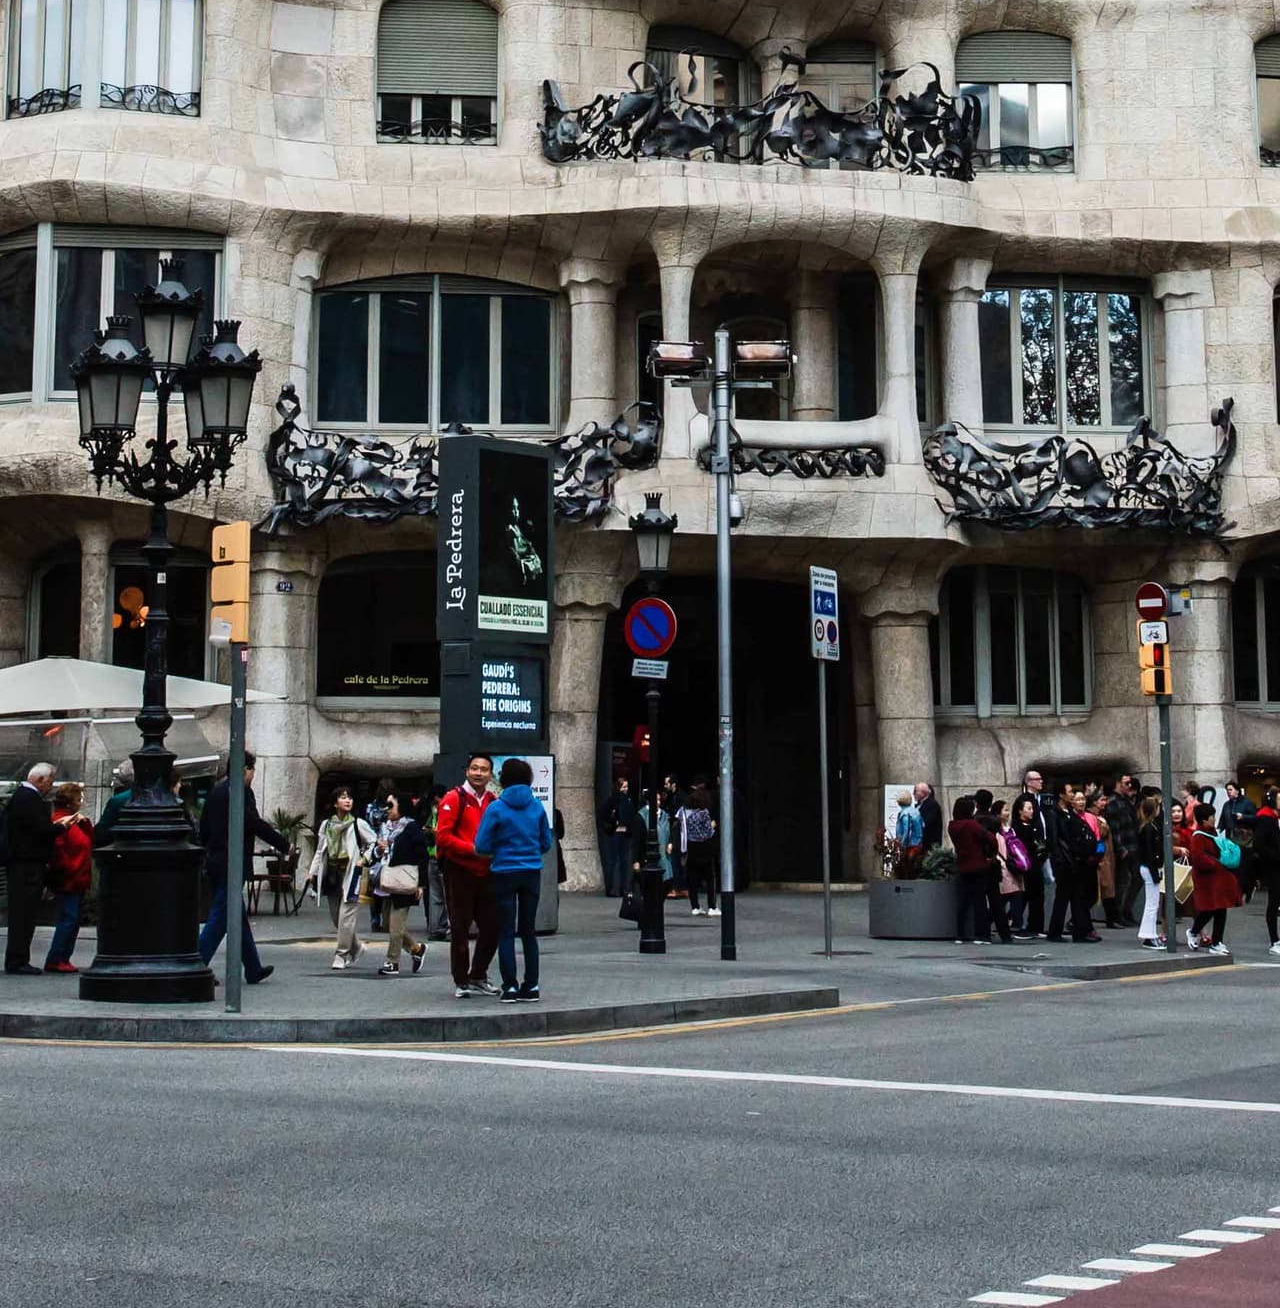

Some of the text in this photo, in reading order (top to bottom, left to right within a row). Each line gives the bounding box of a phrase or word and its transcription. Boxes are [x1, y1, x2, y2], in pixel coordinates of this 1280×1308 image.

[446, 489, 467, 611] La Pedrera
[482, 662, 515, 679] GAUDÍ'S
[392, 675, 428, 684] Pedrera
[482, 680, 521, 696] PEDRERA:
[482, 698, 532, 714] THE ORIGINS
